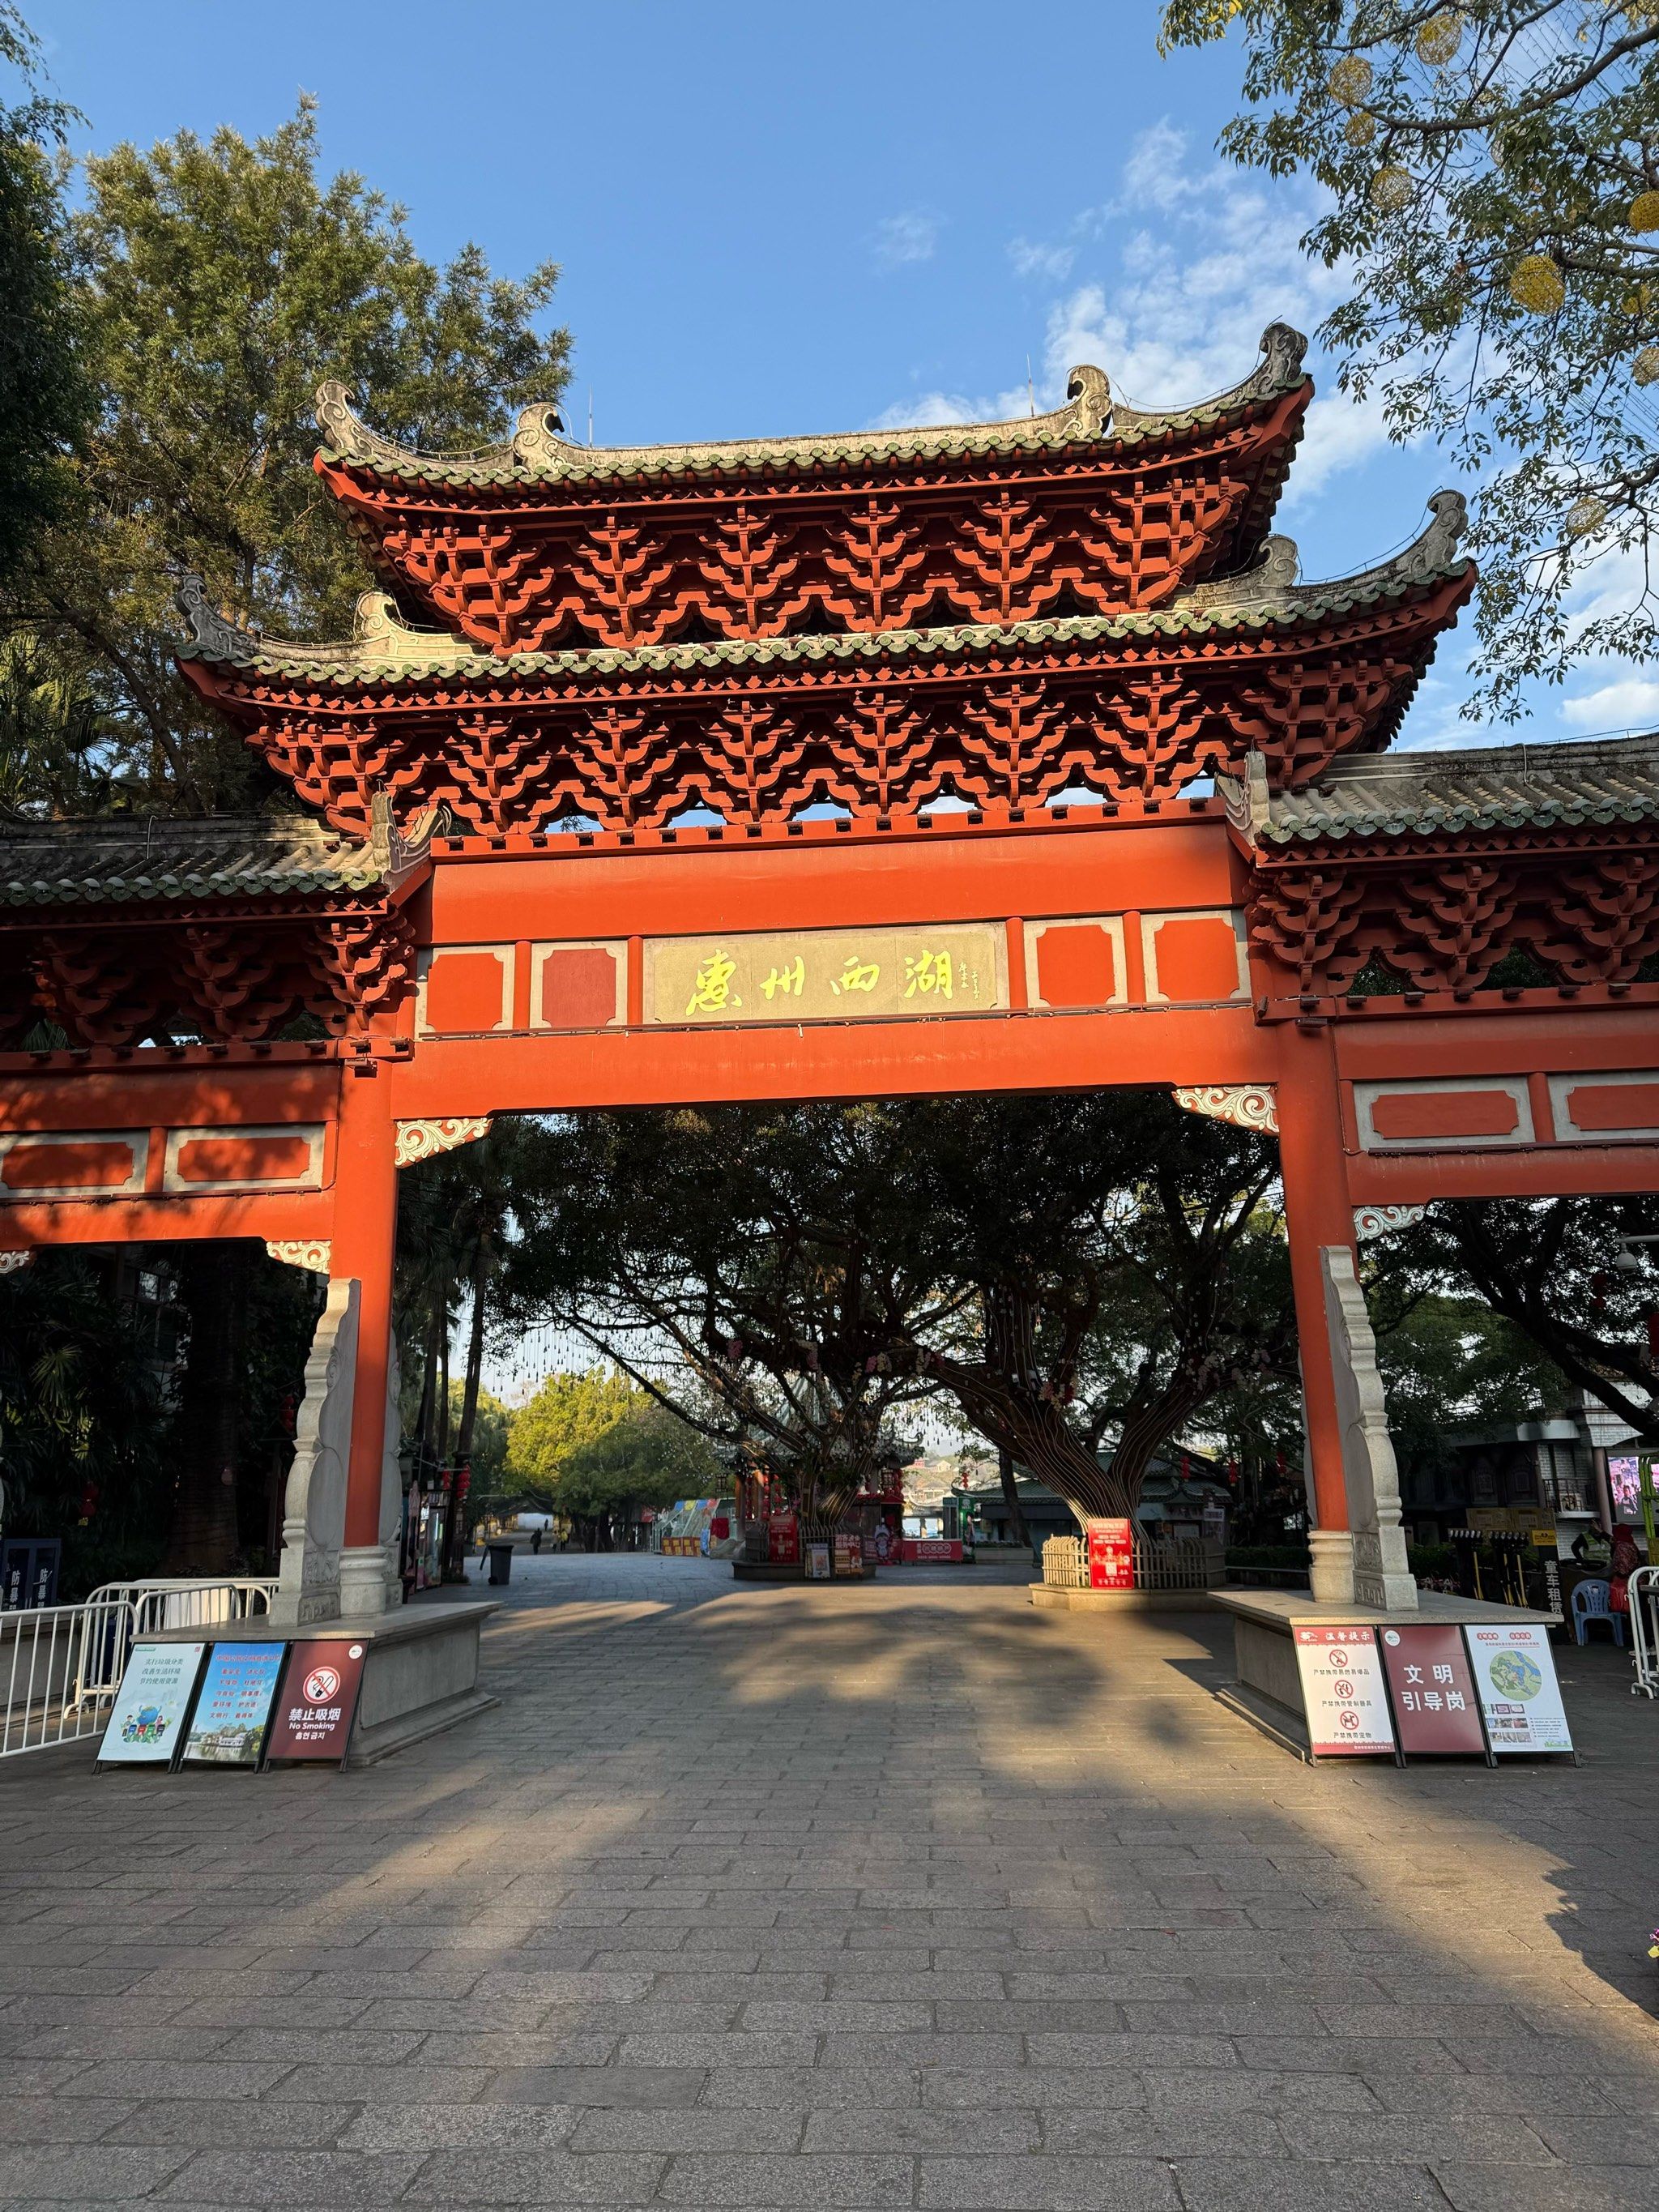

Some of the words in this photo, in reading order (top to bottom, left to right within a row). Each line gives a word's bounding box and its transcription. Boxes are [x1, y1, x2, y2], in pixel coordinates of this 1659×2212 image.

[685, 949, 954, 1015] 惠州西湖
[1544, 1560, 1563, 1615] 童车租赁
[1325, 1631, 1370, 1642] 温馨提示
[1404, 1664, 1454, 1685] 文明
[1401, 1691, 1466, 1711] 引导岗
[288, 1707, 341, 1721] 禁止吸烟
[302, 1723, 335, 1731] Smoking
